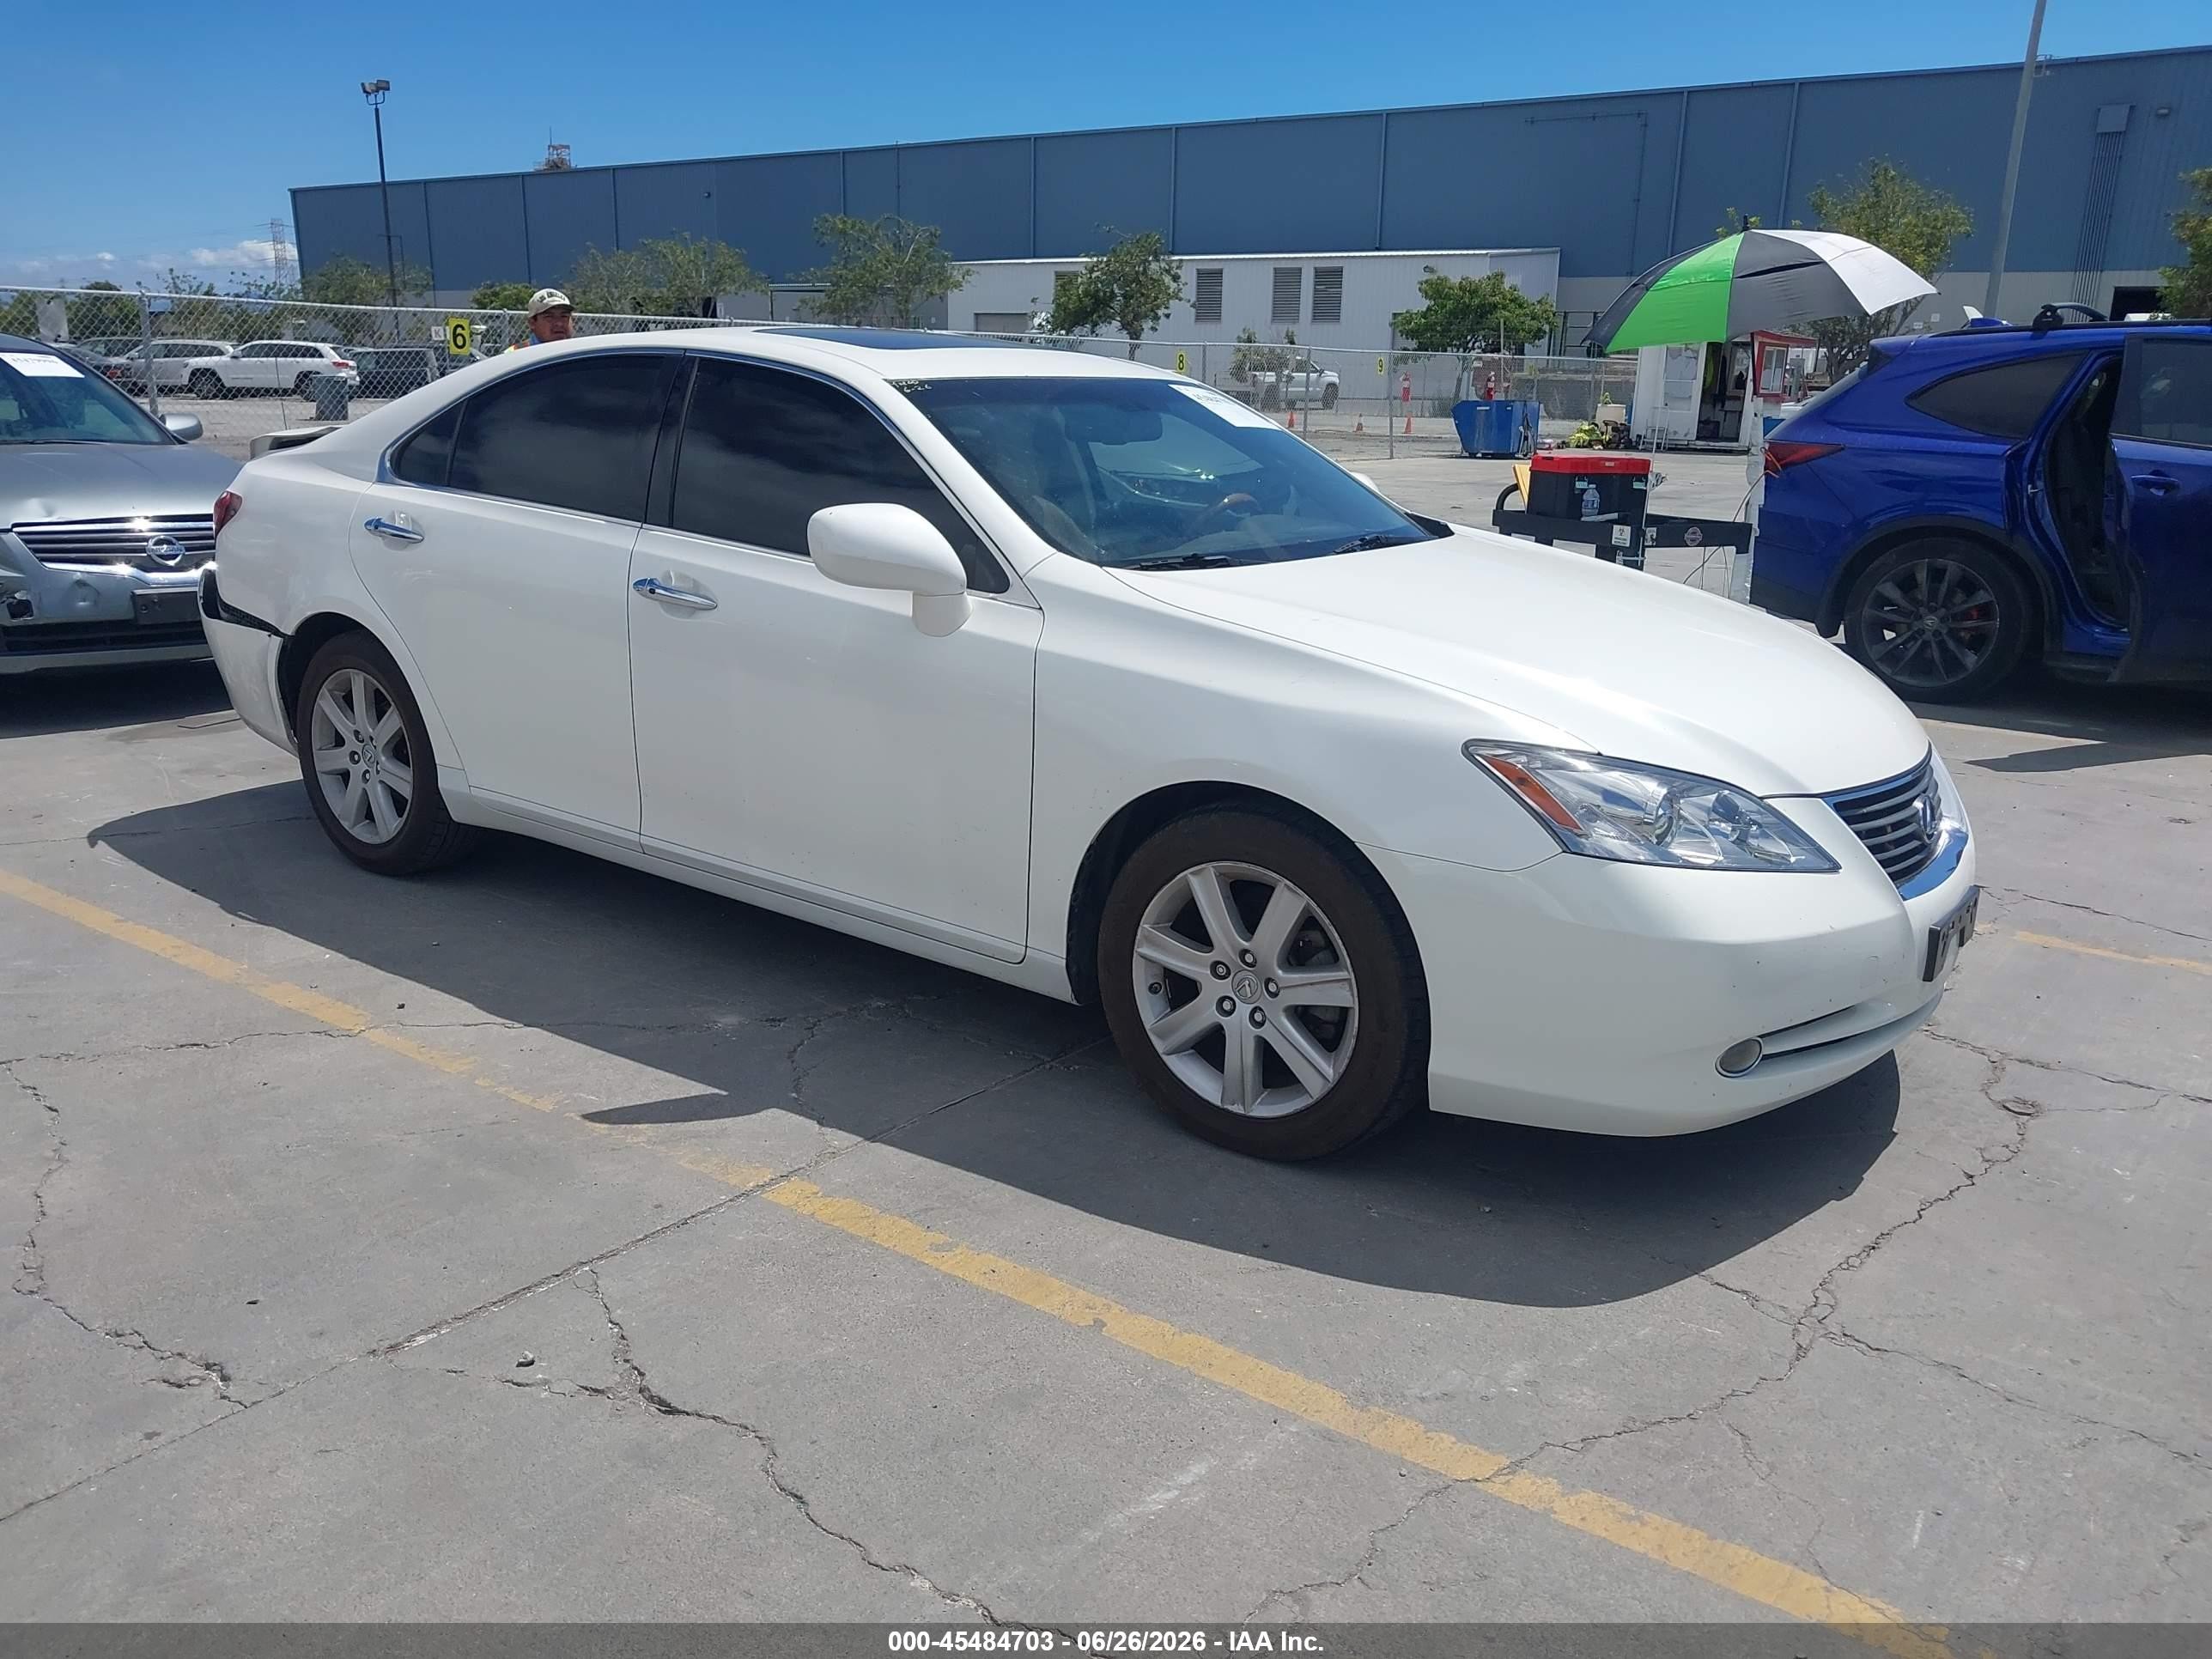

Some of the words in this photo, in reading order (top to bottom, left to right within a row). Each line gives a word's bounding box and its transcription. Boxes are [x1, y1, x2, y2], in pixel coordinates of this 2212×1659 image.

[434, 329, 441, 338] K
[452, 324, 467, 349] 6
[1178, 354, 1184, 370] 8
[1378, 358, 1383, 373] 9
